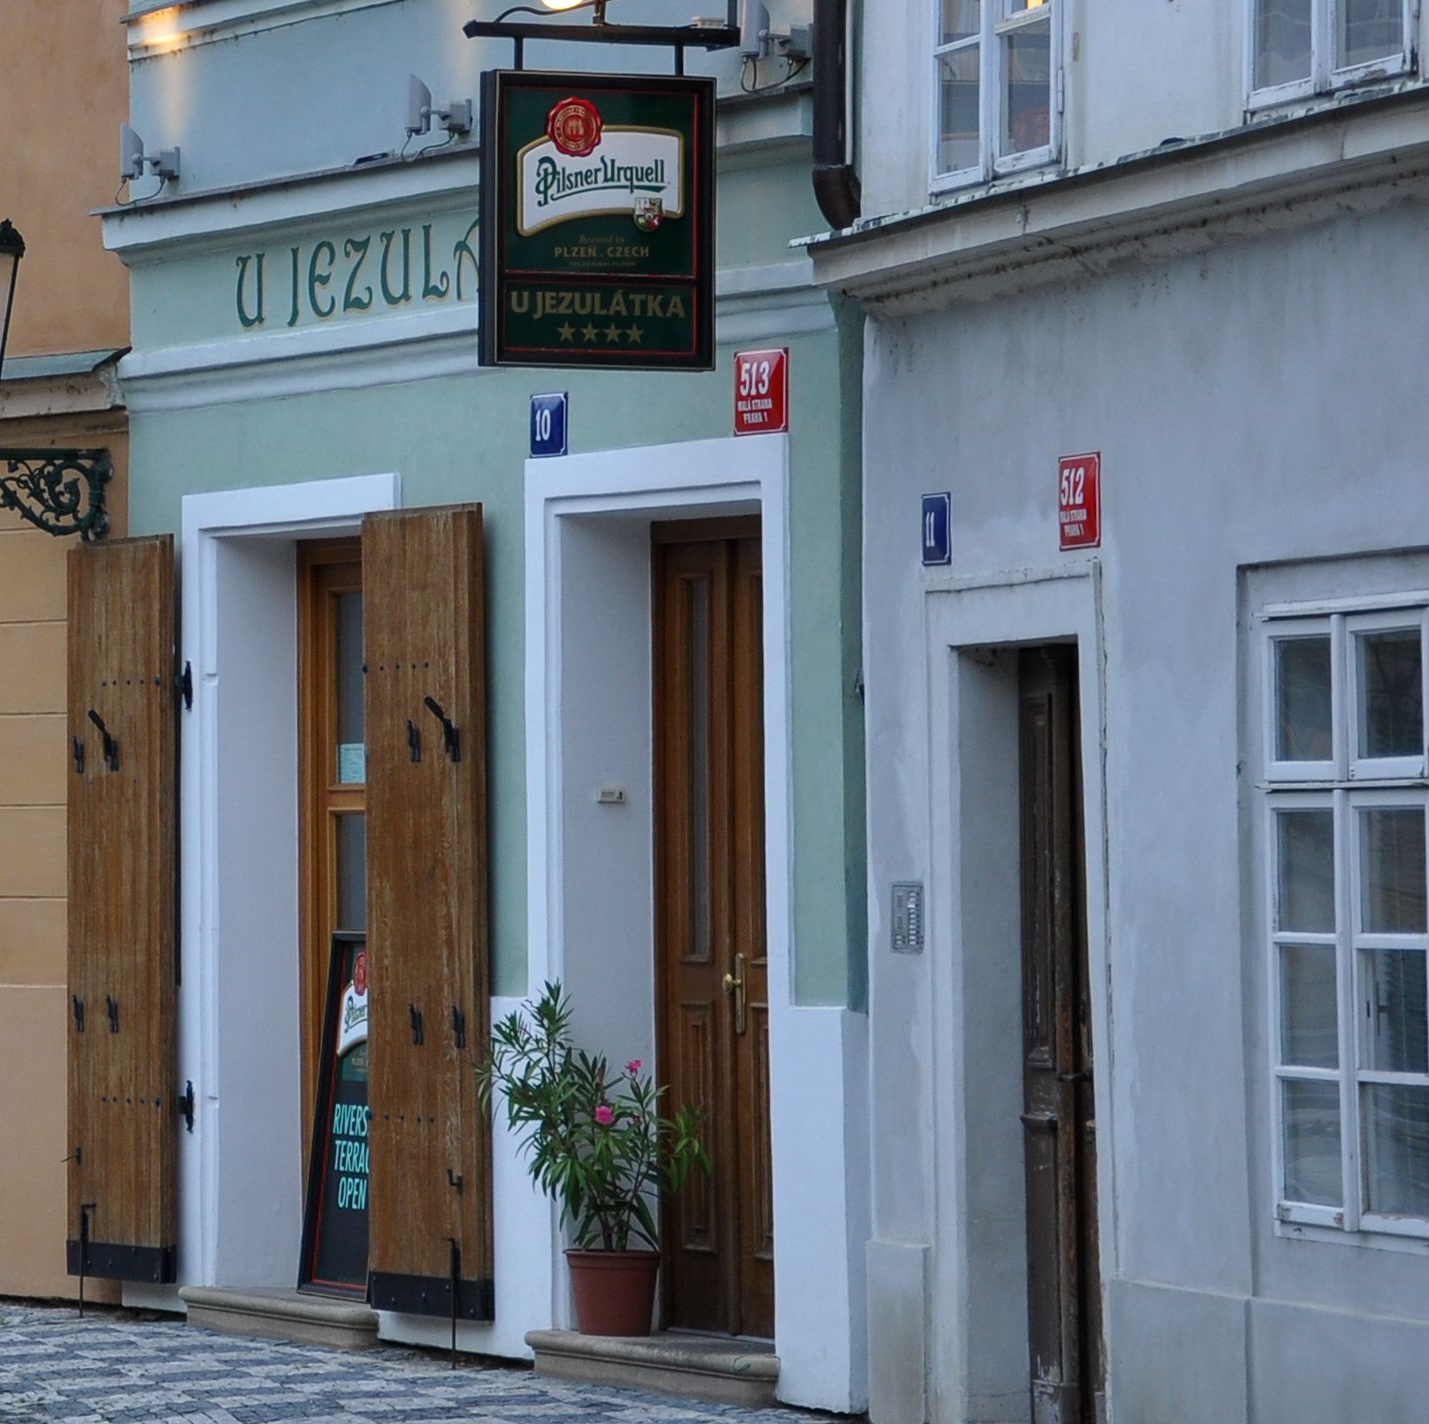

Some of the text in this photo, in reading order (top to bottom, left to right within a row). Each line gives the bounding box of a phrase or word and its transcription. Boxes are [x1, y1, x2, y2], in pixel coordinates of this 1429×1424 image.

[535, 155, 665, 207] Pilsner Urquell
[235, 216, 479, 328] U JEZUL
[510, 289, 686, 320] U JEZULÁTKA
[740, 361, 770, 396] 513
[535, 408, 551, 442] 10
[1060, 467, 1085, 506] 512
[925, 512, 935, 547] 11
[333, 1103, 370, 1137] RIVERS
[338, 1176, 367, 1210] OPEN
